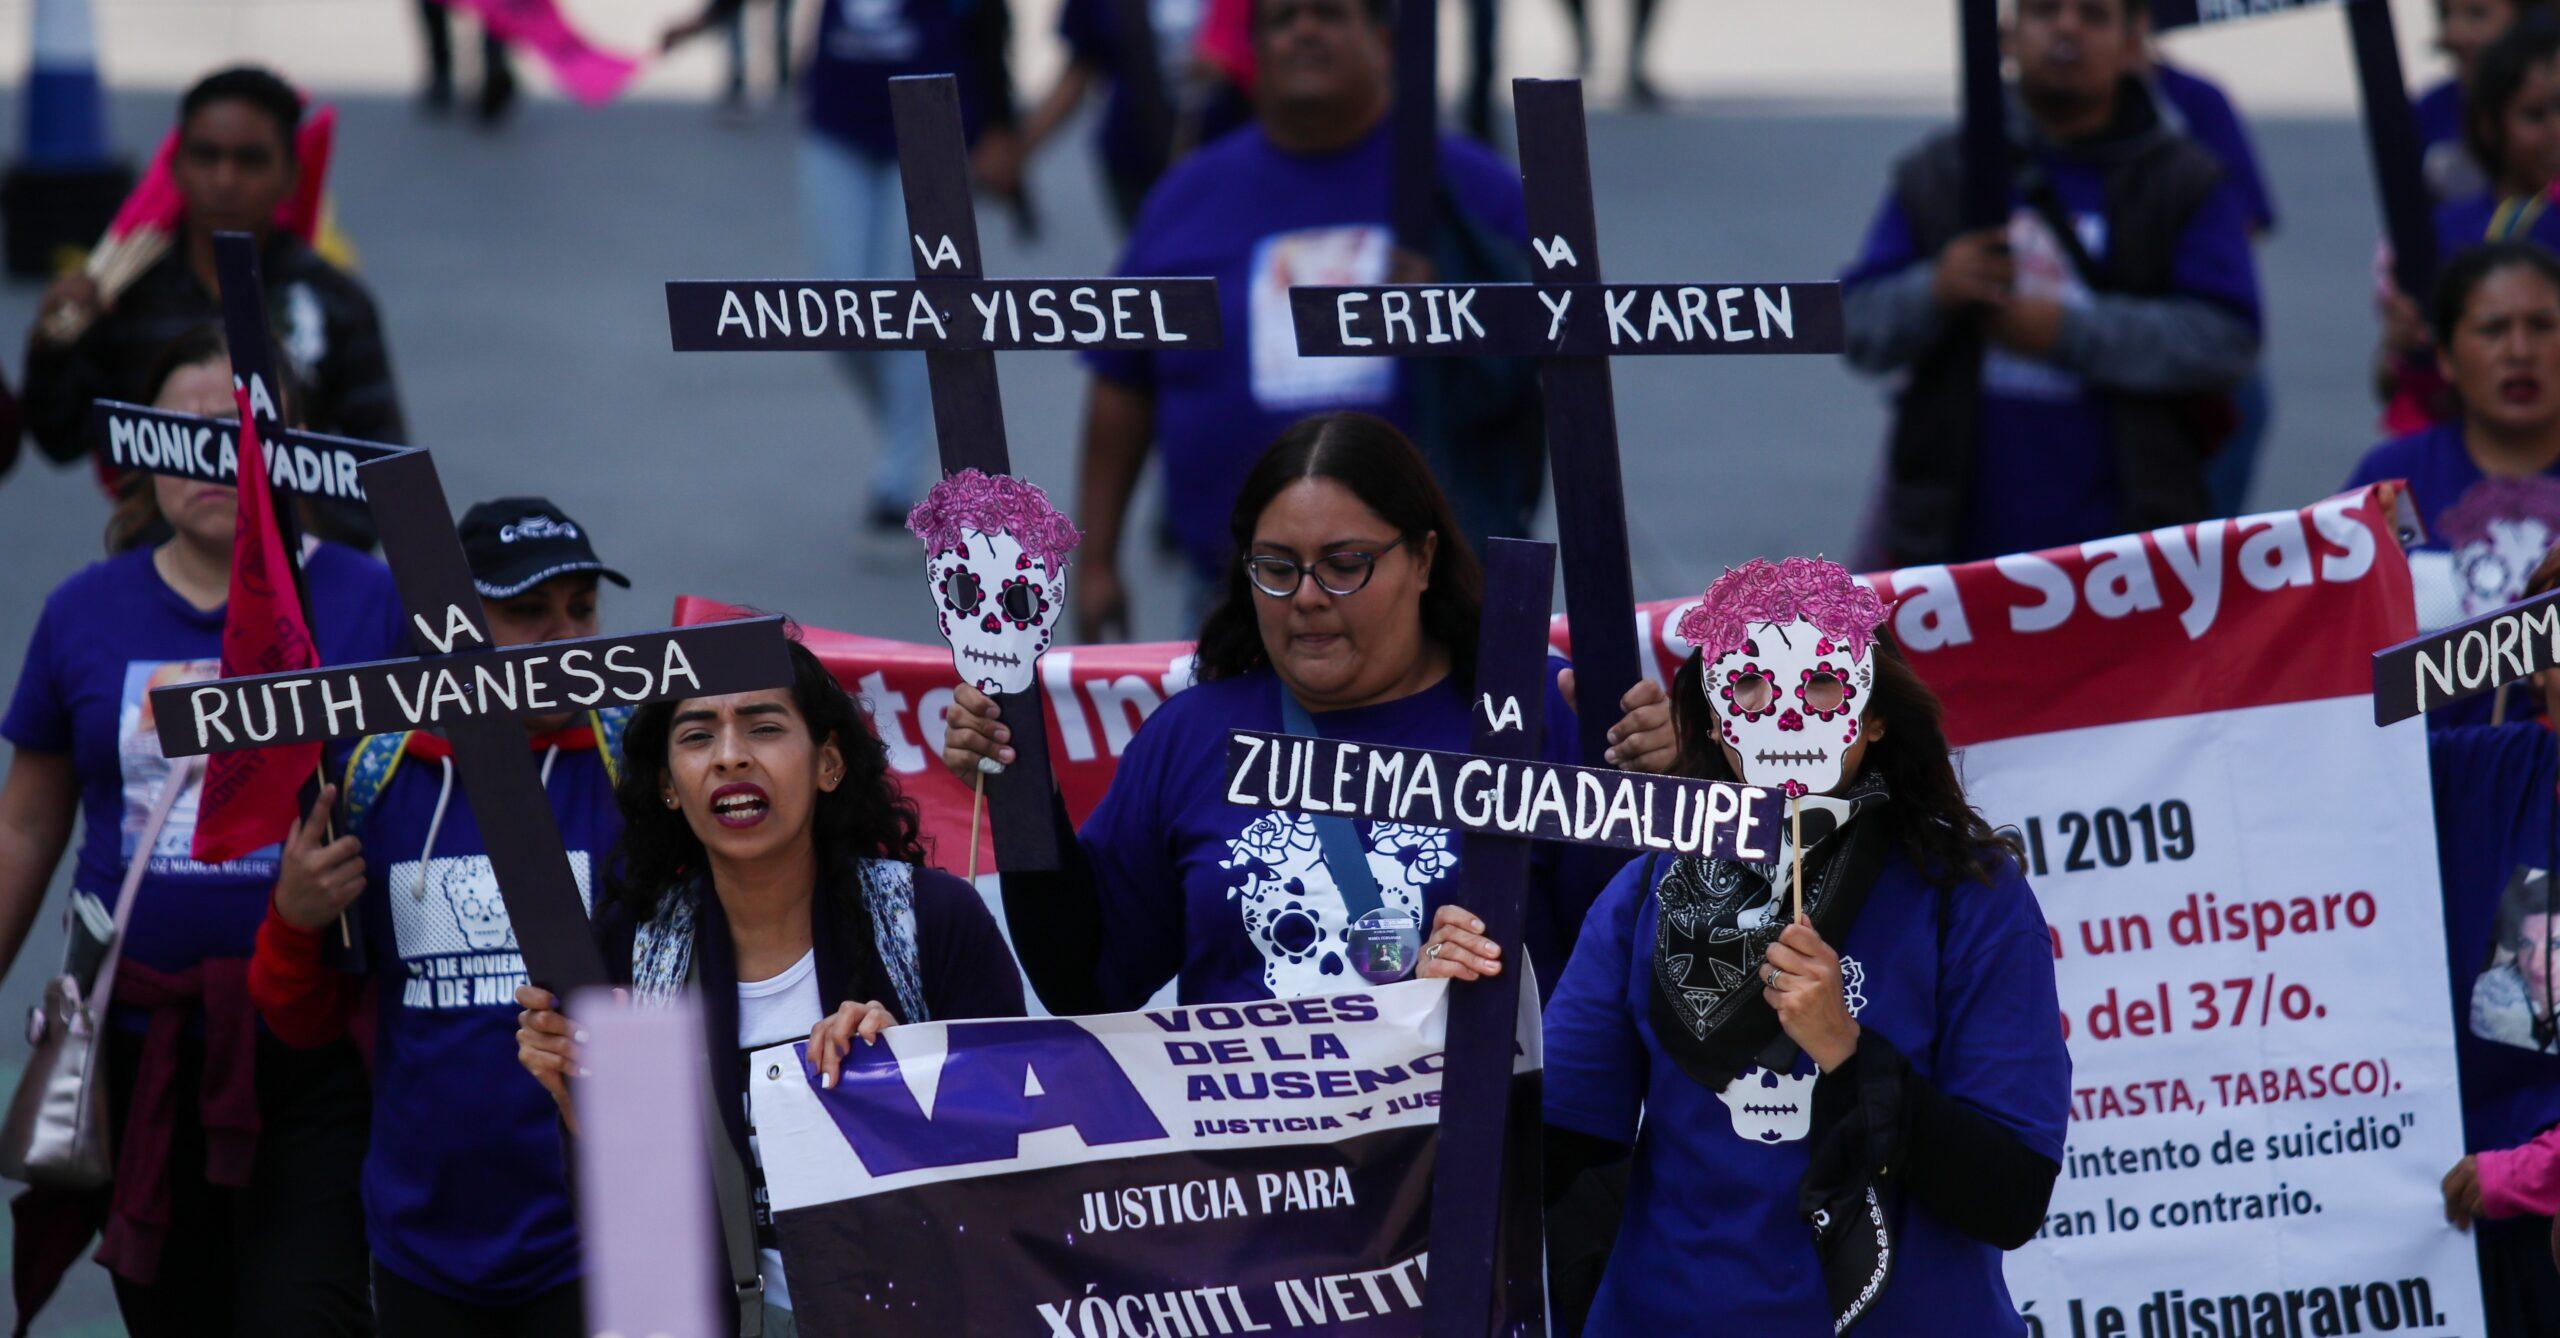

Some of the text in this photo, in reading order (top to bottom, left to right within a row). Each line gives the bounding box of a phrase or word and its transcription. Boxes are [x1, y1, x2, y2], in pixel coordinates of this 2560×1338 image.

[915, 234, 961, 270] VA
[1533, 234, 1577, 269] VA
[717, 287, 1188, 344] ANDREA YISSEL
[1337, 286, 1794, 346] ERIK Y KAREN
[109, 415, 238, 479] MONICA
[1994, 492, 2376, 640] Sayas
[414, 603, 484, 653] VA
[191, 673, 366, 748] RUTH
[387, 639, 700, 723] VANESSA
[1042, 652, 1201, 762] In
[1484, 692, 1523, 732] VA
[1228, 735, 1767, 860] ZULEMA GUADALUPE
[2058, 799, 2195, 873] 2019
[2080, 913, 2152, 956] un
[2169, 890, 2377, 953] disparo
[436, 956, 460, 977] DE
[436, 977, 469, 1008] DE
[1144, 993, 1379, 1033] VOCES
[2087, 982, 2172, 1040] del
[2189, 973, 2328, 1031] 37/o.
[1164, 1033, 1350, 1066] DE LA
[2212, 1057, 2402, 1108] TABASCO).
[1194, 1115, 1343, 1137] JUSTICIA
[1345, 1106, 1373, 1121] Y
[2067, 1112, 2415, 1179] intento de suicidio"
[1080, 1165, 1356, 1234] JUSTICIA PARA
[2030, 1182, 2322, 1241] ran lo contrario.
[1036, 1282, 1272, 1338] XÓCHITL
[2138, 1275, 2446, 1338] dispararon.
